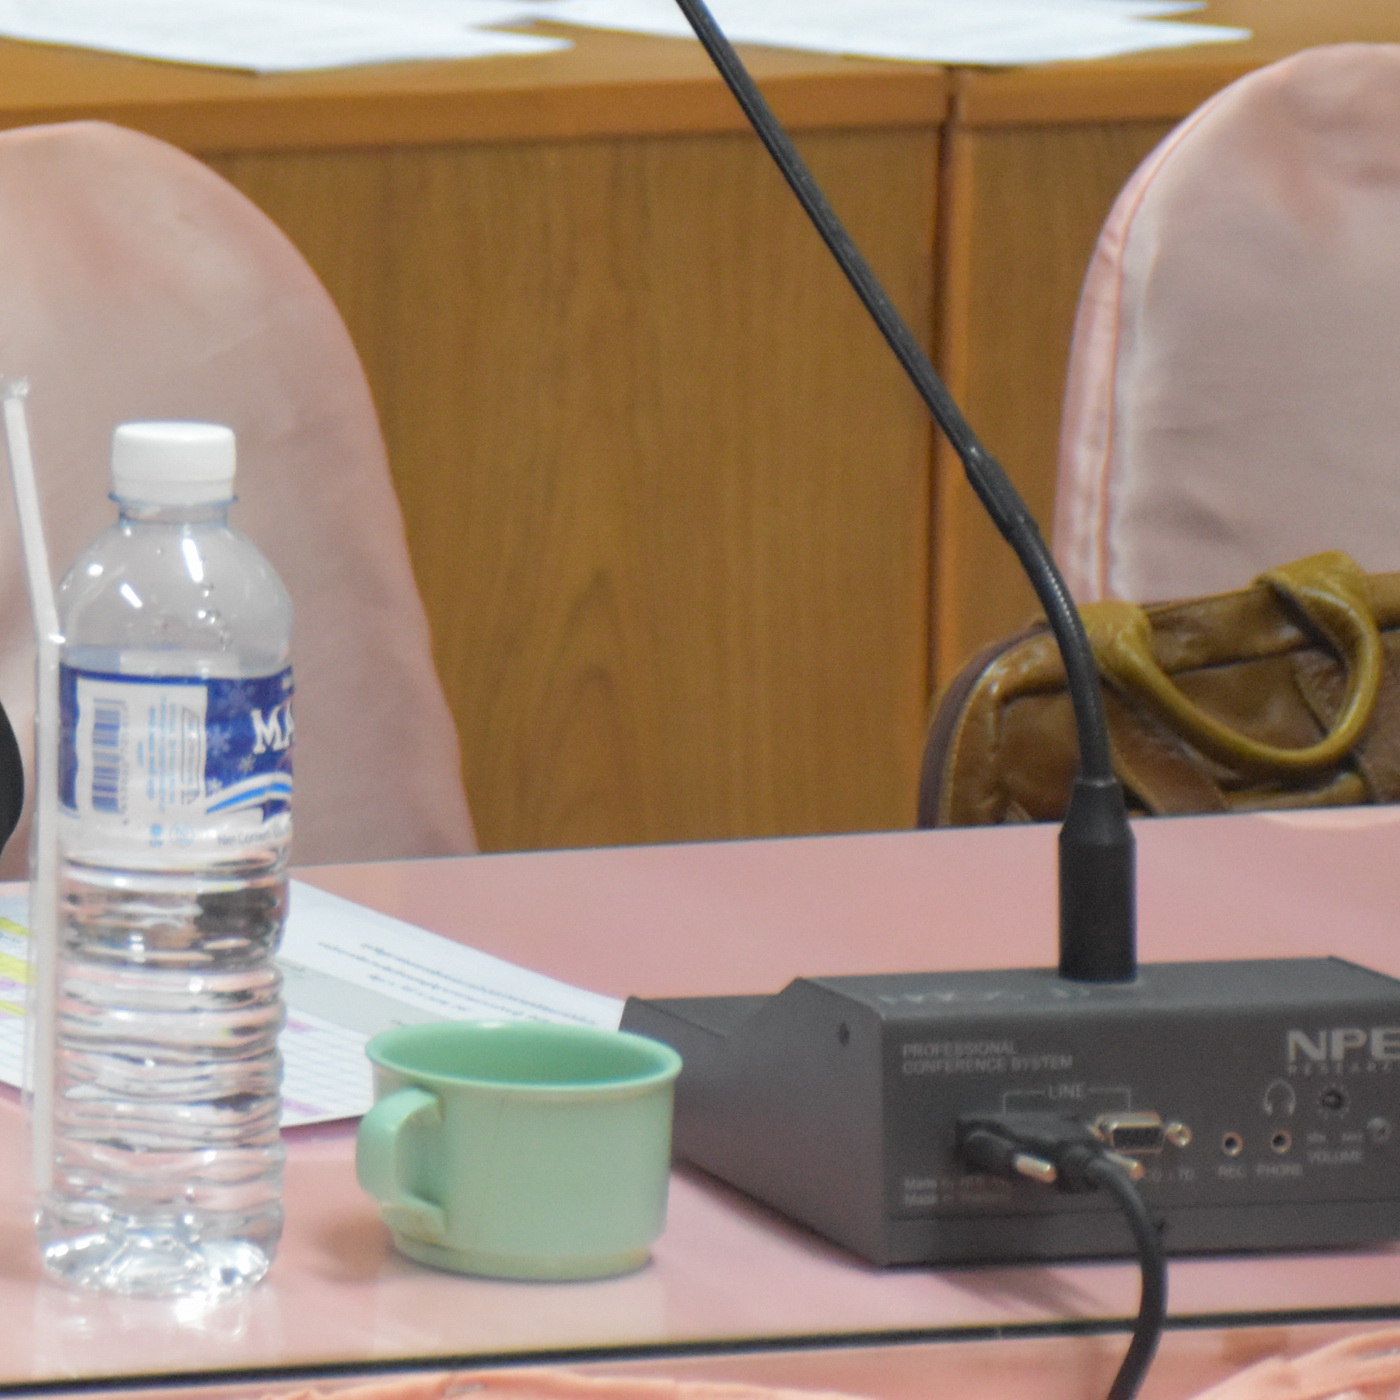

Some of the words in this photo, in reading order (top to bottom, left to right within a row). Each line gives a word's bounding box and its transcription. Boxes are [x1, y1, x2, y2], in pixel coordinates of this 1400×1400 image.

[902, 1057, 1007, 1075] CONFERENCE
[1011, 1054, 1073, 1071] SYSTEM
[1048, 1083, 1086, 1099] LINE
